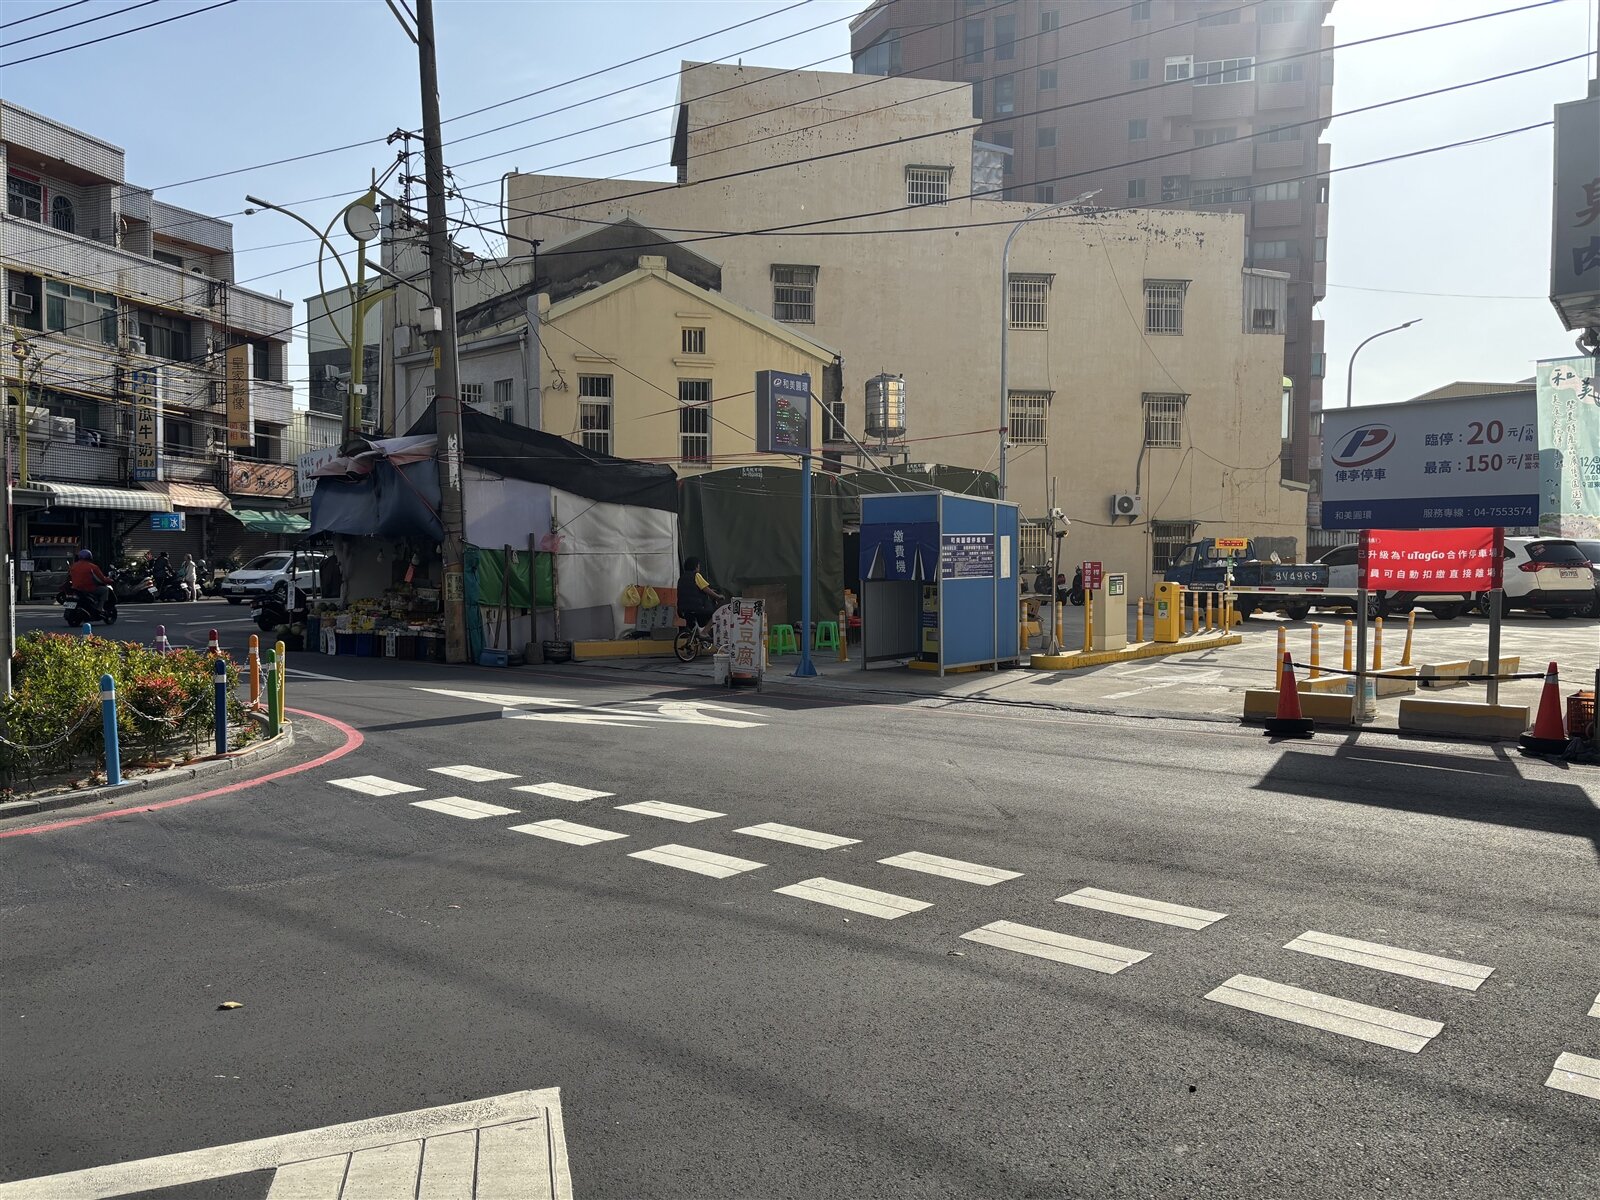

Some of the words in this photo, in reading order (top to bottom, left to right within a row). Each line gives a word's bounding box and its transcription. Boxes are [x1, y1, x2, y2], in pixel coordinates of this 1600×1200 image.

[232, 357, 245, 410] 皇家影像
[138, 388, 153, 457] 木瓜牛奶
[1467, 420, 1504, 446] 20
[1335, 468, 1387, 482] 俥亭停車
[1466, 453, 1503, 472] 150
[893, 529, 906, 573] 繳費機
[1275, 571, 1318, 581] 8V4965
[737, 606, 756, 667] 臭豆腐
